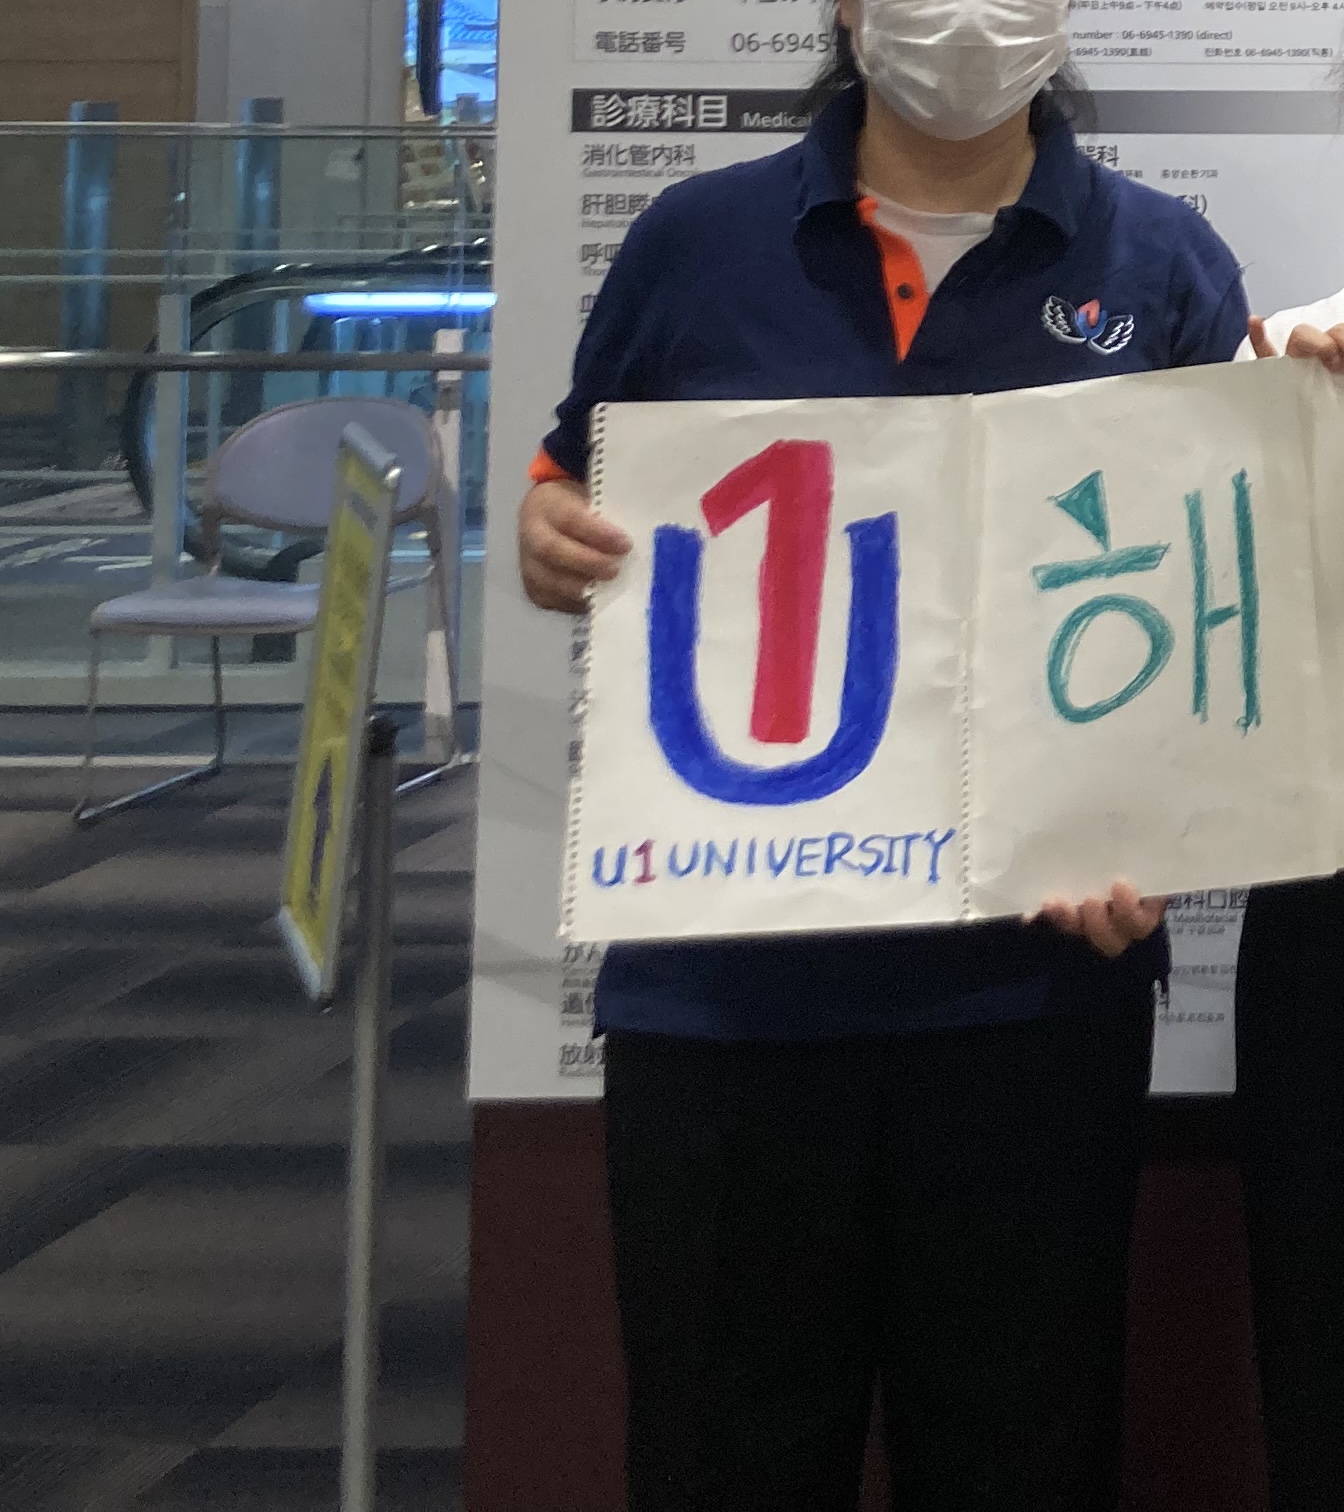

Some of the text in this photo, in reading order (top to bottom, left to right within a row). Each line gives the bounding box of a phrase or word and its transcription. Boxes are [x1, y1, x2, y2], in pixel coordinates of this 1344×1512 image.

[594, 30, 687, 54] 電話番号
[591, 93, 729, 129] 診療科目
[583, 143, 697, 166] 消化管内科
[582, 193, 652, 215] 肝胆膵
[666, 826, 960, 885] UNIVERSITY
